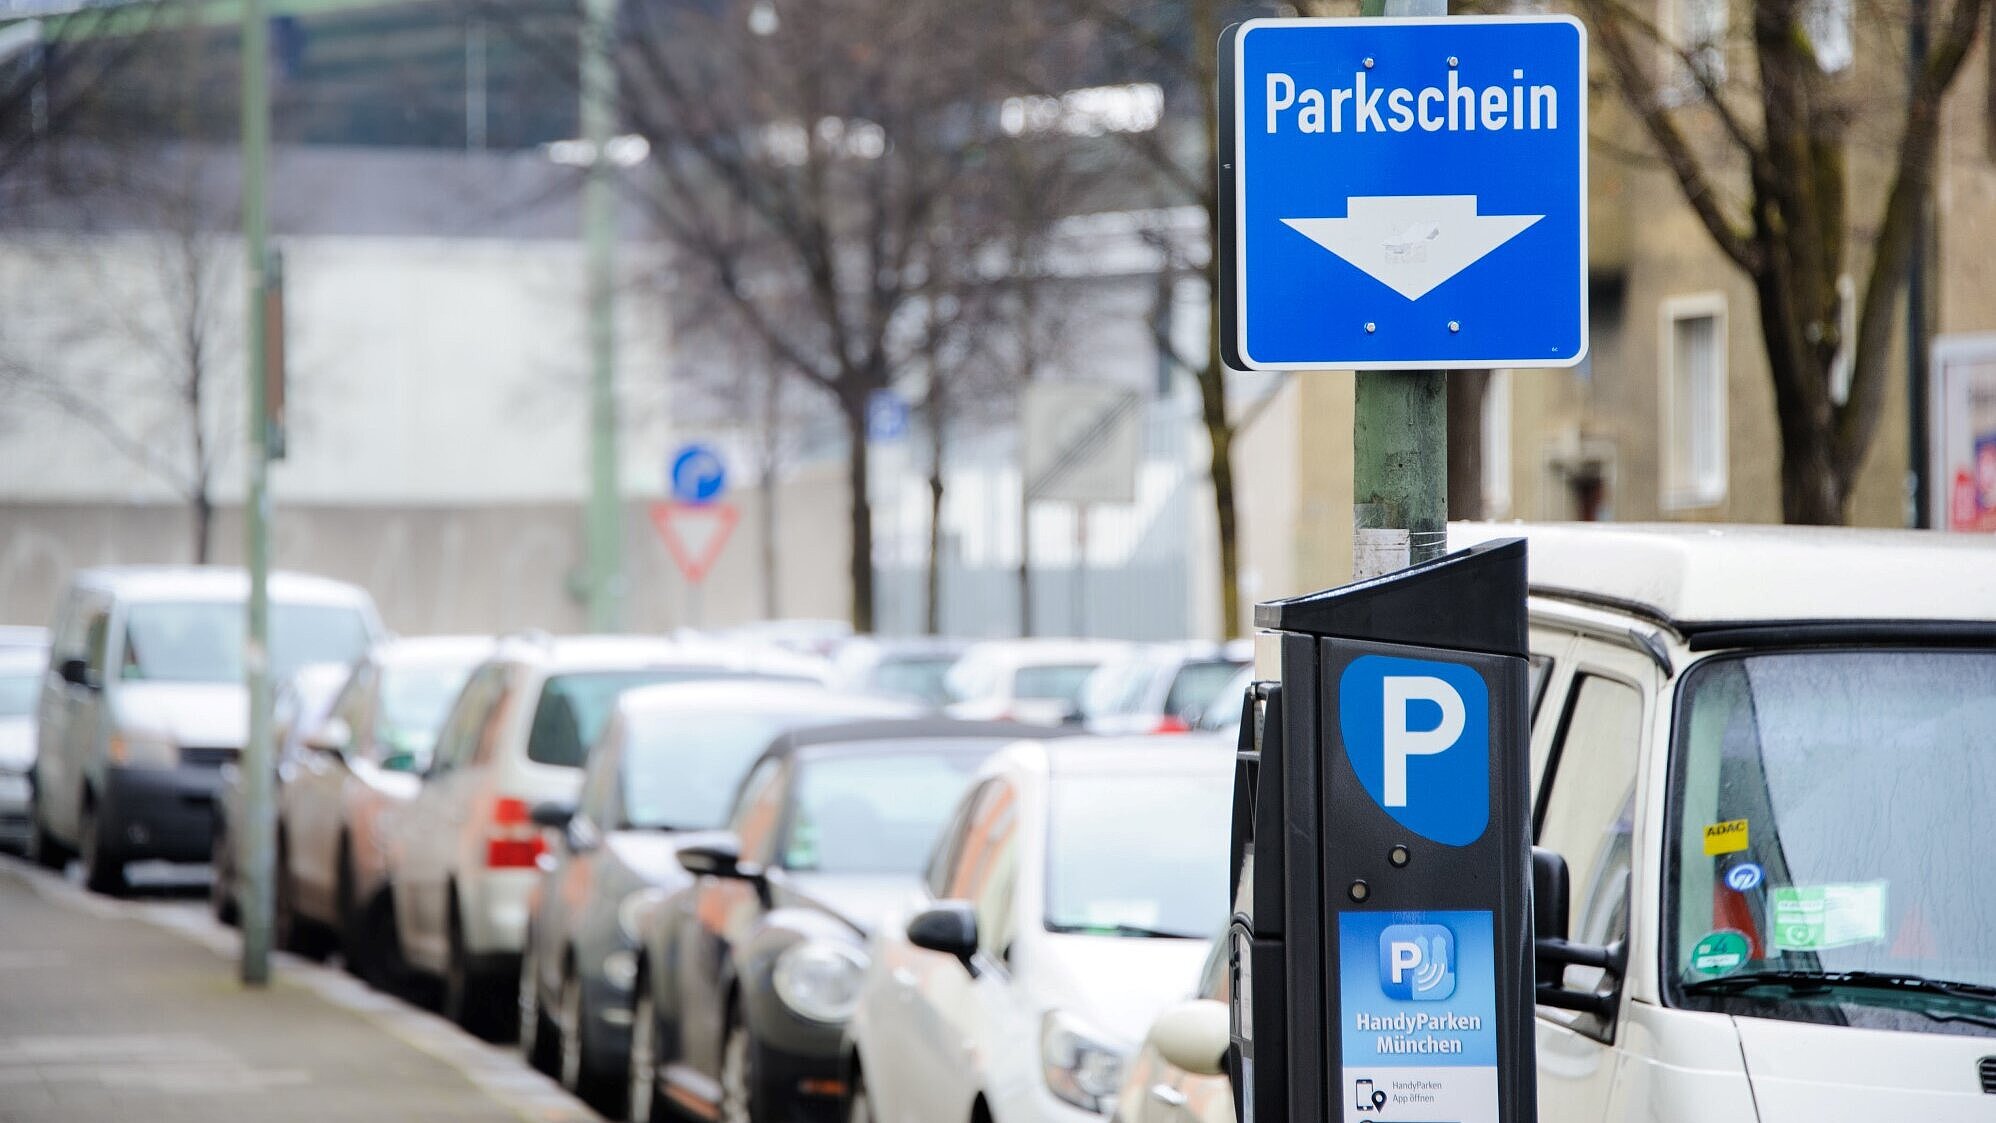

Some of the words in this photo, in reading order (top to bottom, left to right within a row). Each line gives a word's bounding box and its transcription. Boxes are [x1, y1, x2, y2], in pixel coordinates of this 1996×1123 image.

[1266, 69, 1558, 134] Parkschein
[1383, 676, 1466, 807] P
[1706, 821, 1746, 837] ADAC
[1391, 942, 1422, 983] P
[1356, 1012, 1481, 1035] HandyParken
[1376, 1035, 1462, 1054] München
[1392, 1080, 1442, 1092] HandyParken
[1392, 1094, 1408, 1104] App
[1409, 1094, 1435, 1103] öffnen
